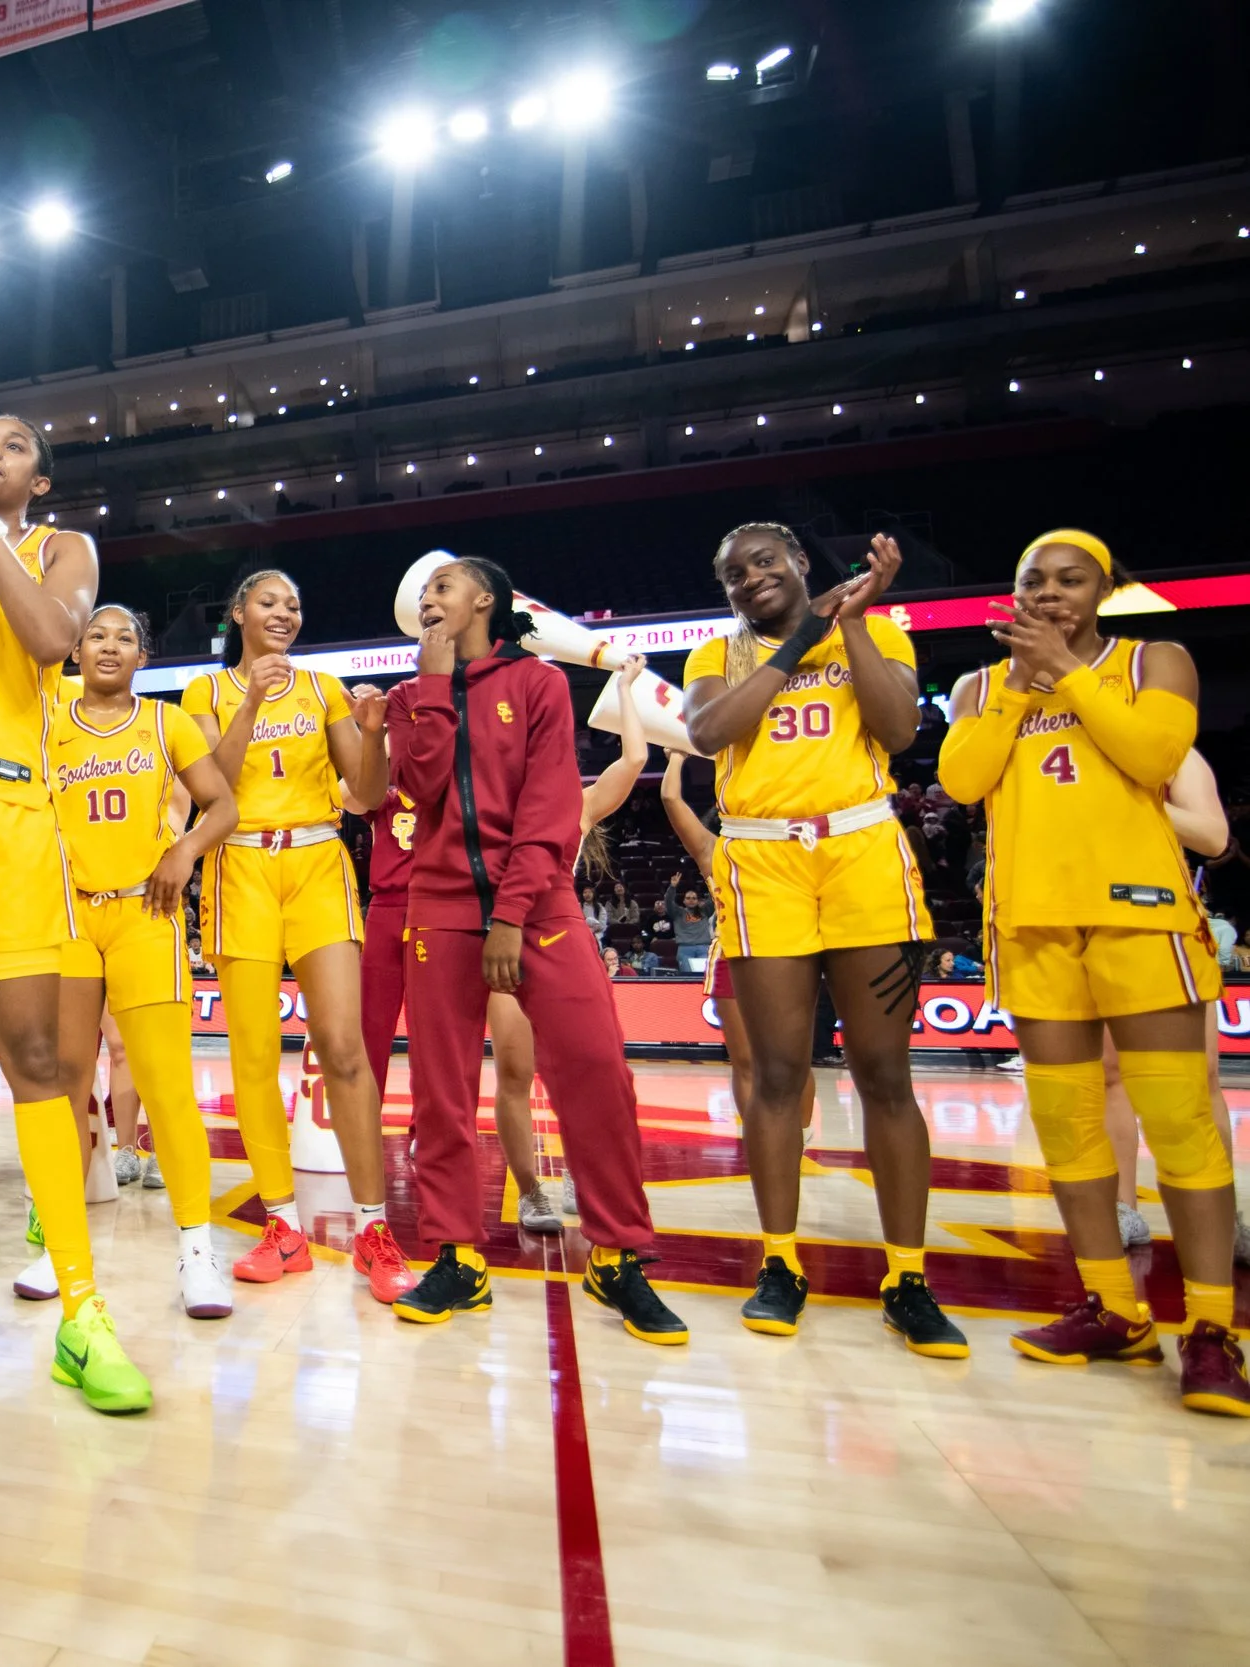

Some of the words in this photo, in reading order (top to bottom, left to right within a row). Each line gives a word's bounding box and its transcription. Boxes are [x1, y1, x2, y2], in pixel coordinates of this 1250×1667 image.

[351, 651, 416, 670] SUNDA
[626, 630, 674, 646] 2:00
[683, 626, 714, 642] PM
[293, 712, 317, 737] Cal
[768, 702, 831, 743] 30
[57, 754, 123, 793] Southern
[126, 748, 154, 775] Cal
[270, 748, 285, 778] 1
[1040, 744, 1079, 786] 4
[86, 789, 127, 823] 10
